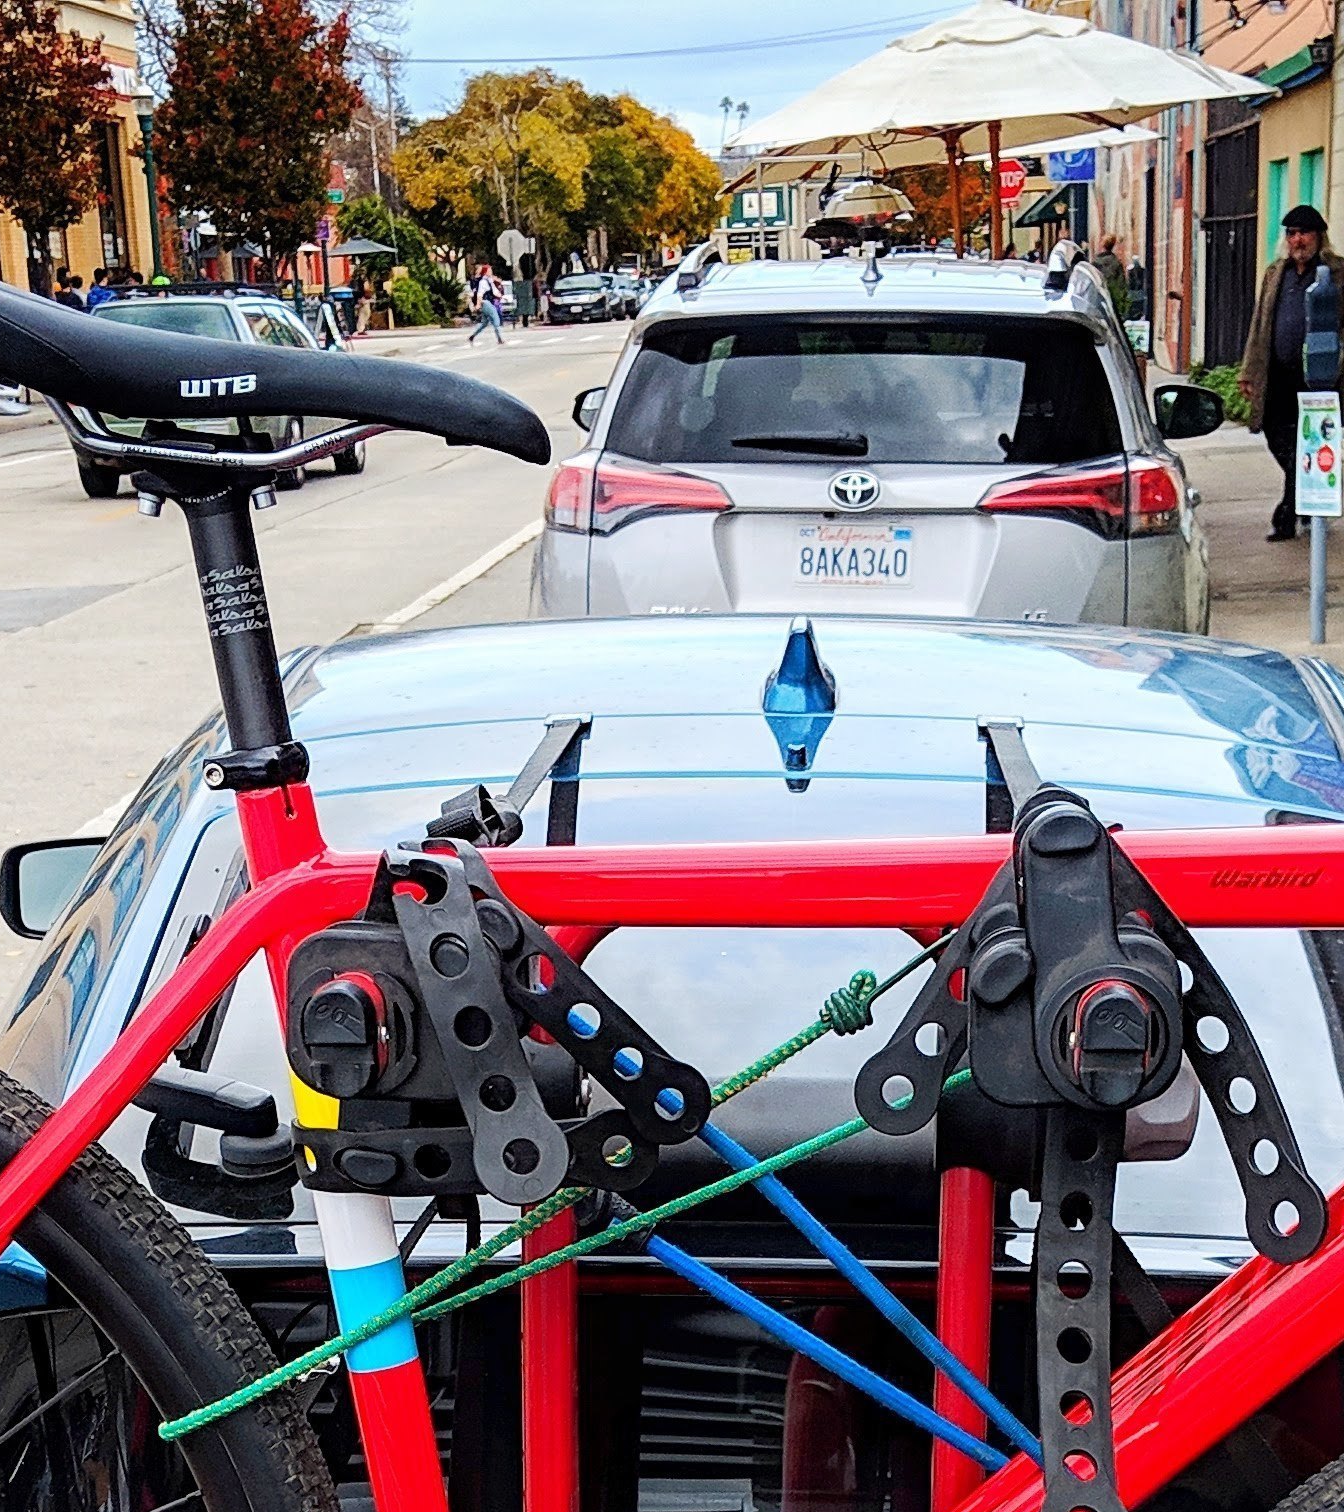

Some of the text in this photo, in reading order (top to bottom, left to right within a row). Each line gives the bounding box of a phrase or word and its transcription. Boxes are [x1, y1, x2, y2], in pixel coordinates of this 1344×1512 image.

[1000, 171, 1024, 188] TOP
[180, 373, 257, 398] WTB
[800, 547, 907, 577] 8AKA340
[1210, 867, 1324, 889] Warbird
